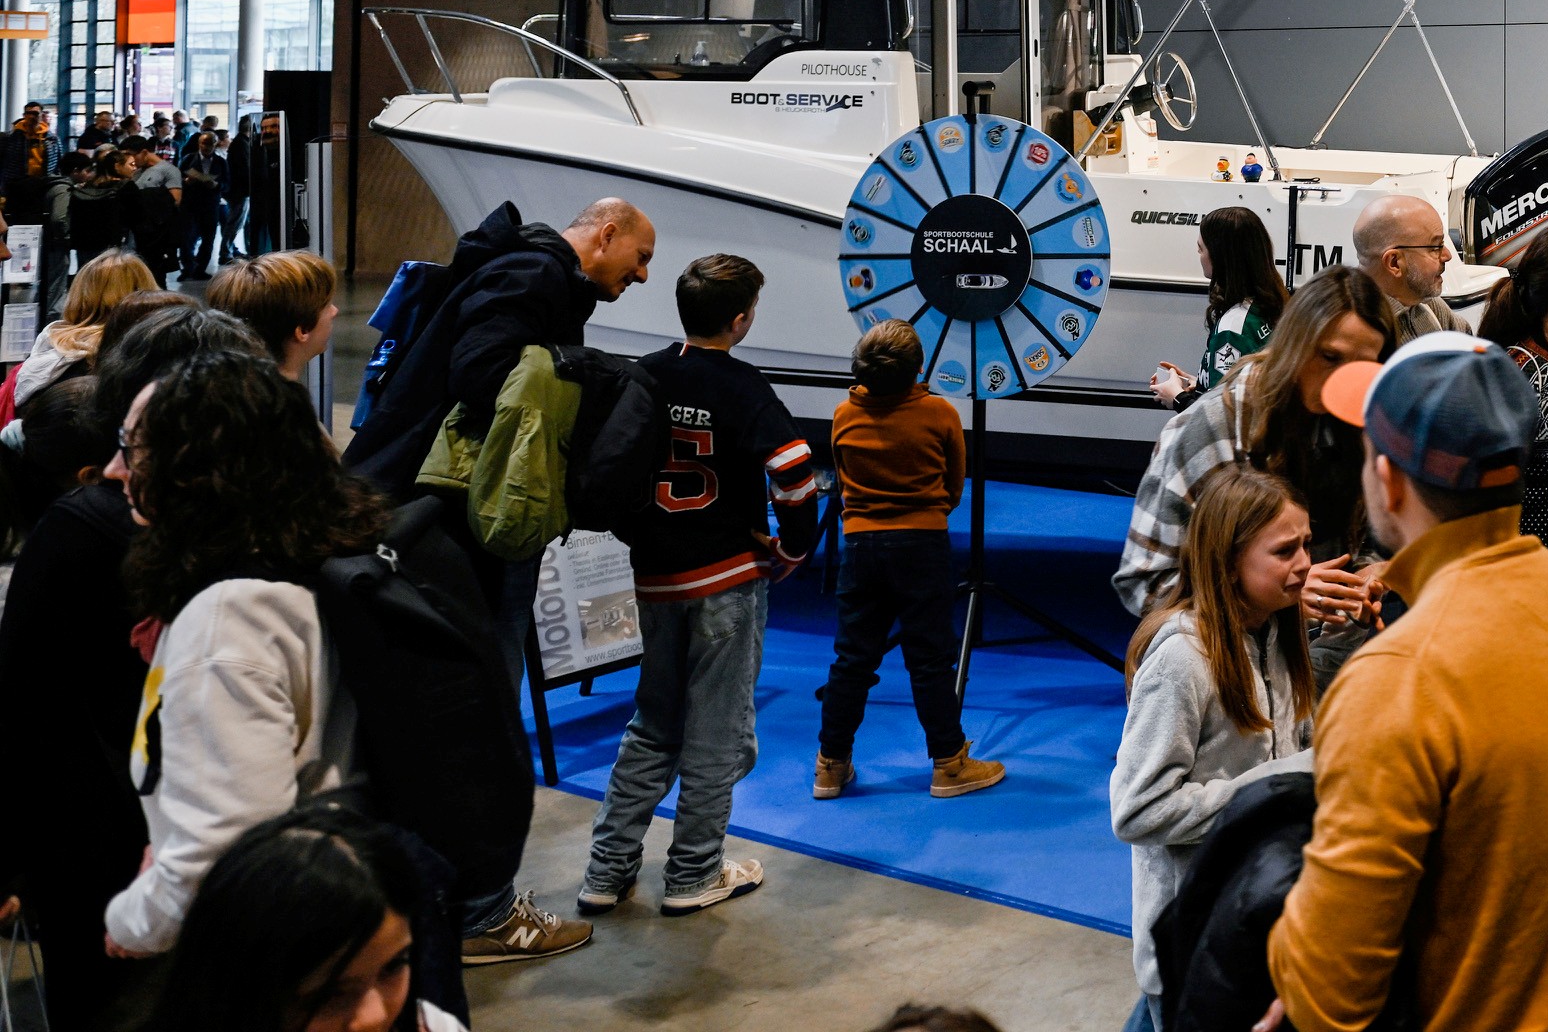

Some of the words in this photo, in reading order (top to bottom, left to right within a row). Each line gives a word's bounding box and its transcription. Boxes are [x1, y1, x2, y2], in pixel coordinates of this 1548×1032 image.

[801, 64, 867, 76] PILOTHOUSE
[1131, 210, 1205, 226] QUICKSIL
[923, 230, 994, 238] SPORTBOOTSCHULE
[923, 238, 994, 254] SCHAAL
[668, 404, 712, 427] GER
[655, 426, 719, 513] 5
